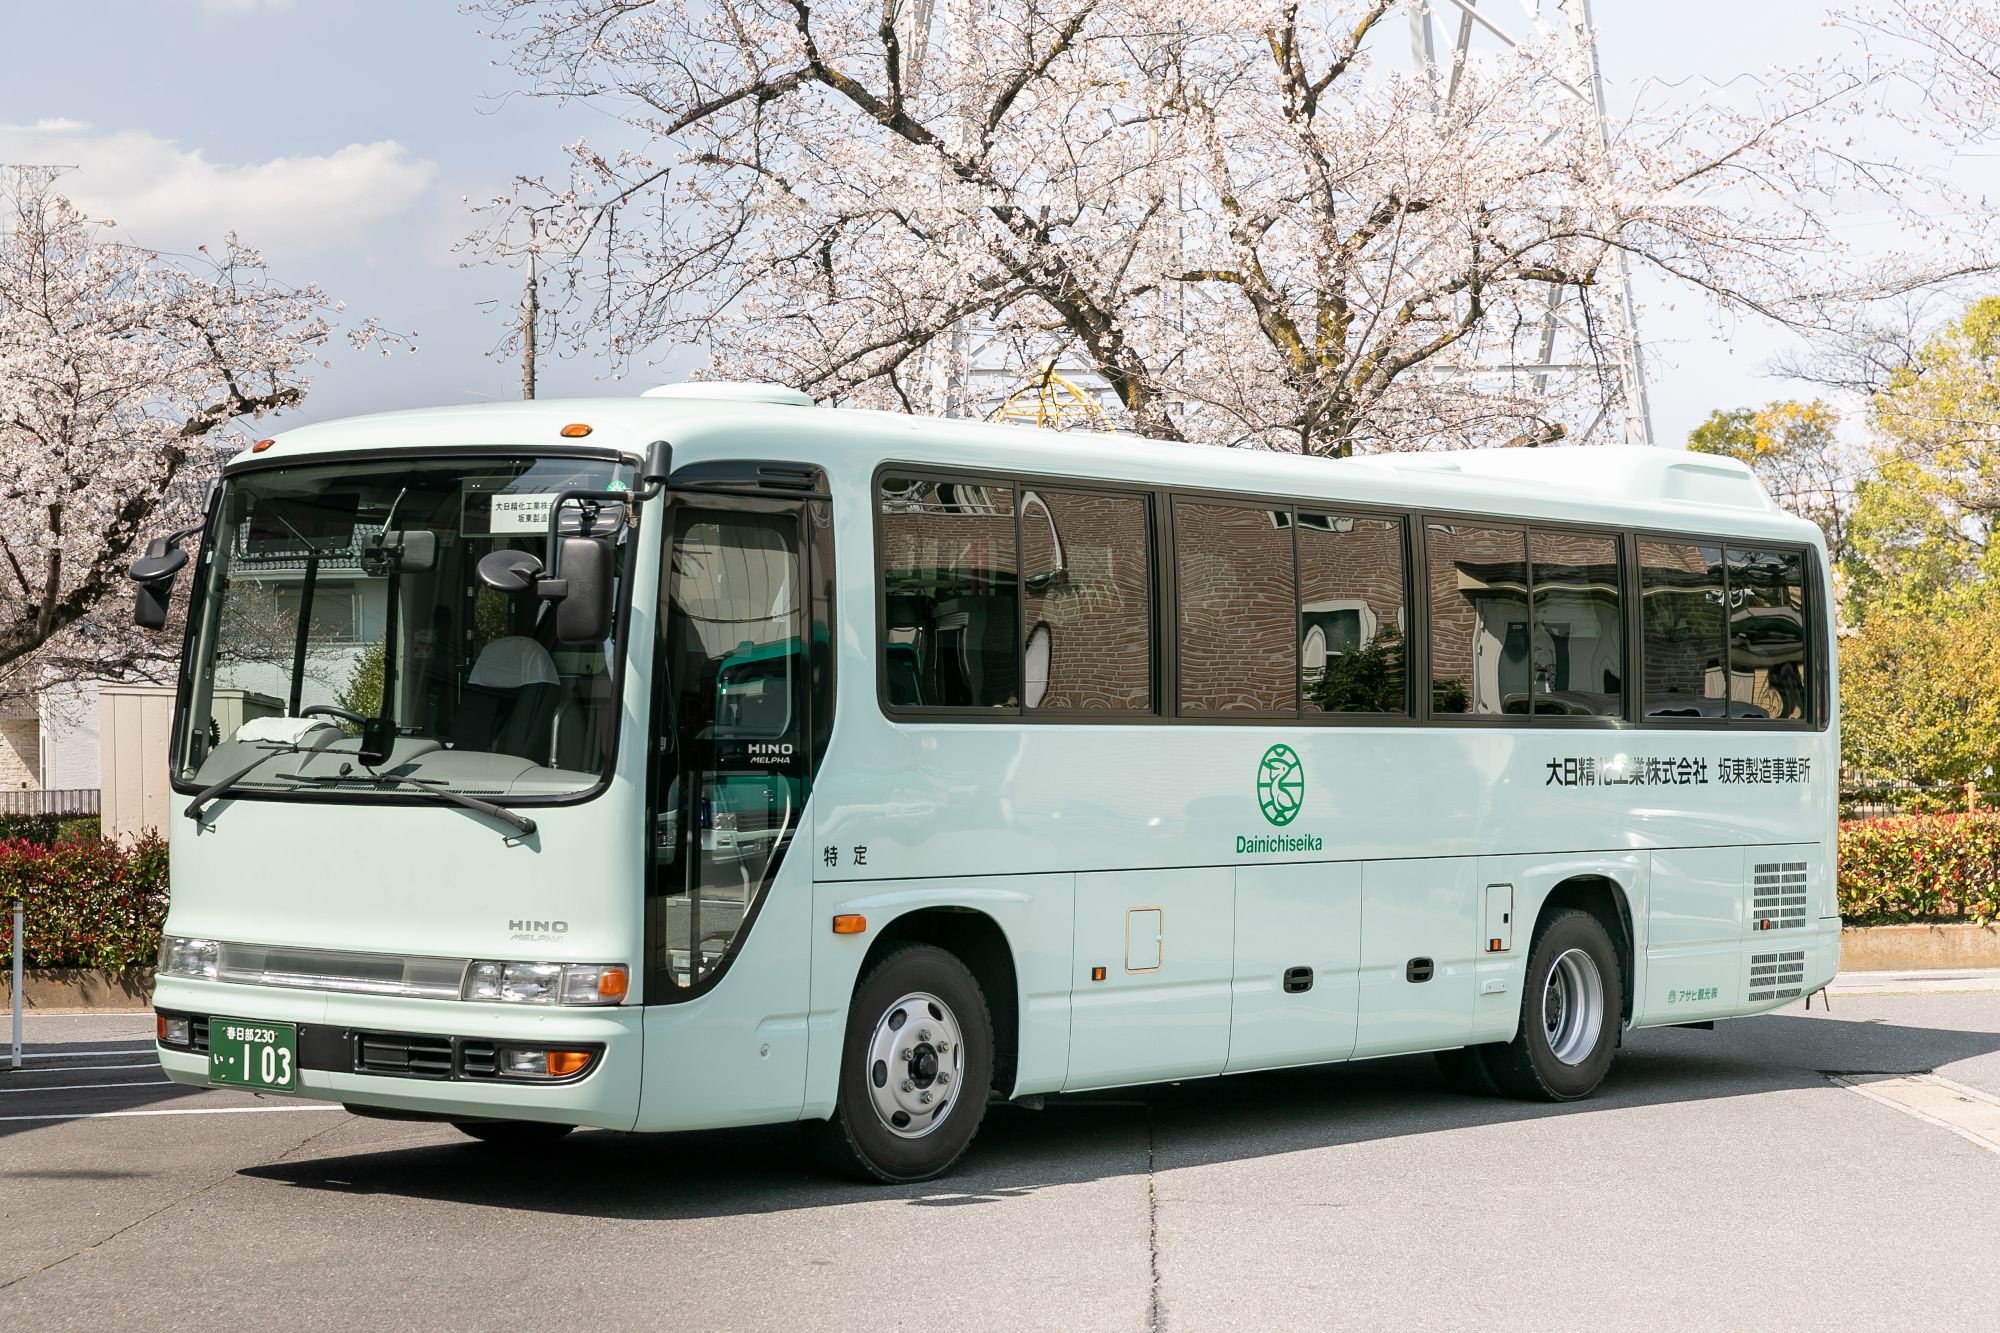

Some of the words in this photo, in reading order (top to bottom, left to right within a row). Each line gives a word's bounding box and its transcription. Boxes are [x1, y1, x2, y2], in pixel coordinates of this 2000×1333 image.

[748, 744, 793, 754] HINO
[1718, 757, 1811, 784] 坂東製造事業所
[1236, 834, 1323, 853] Dainichiseika
[508, 919, 568, 933] HINO
